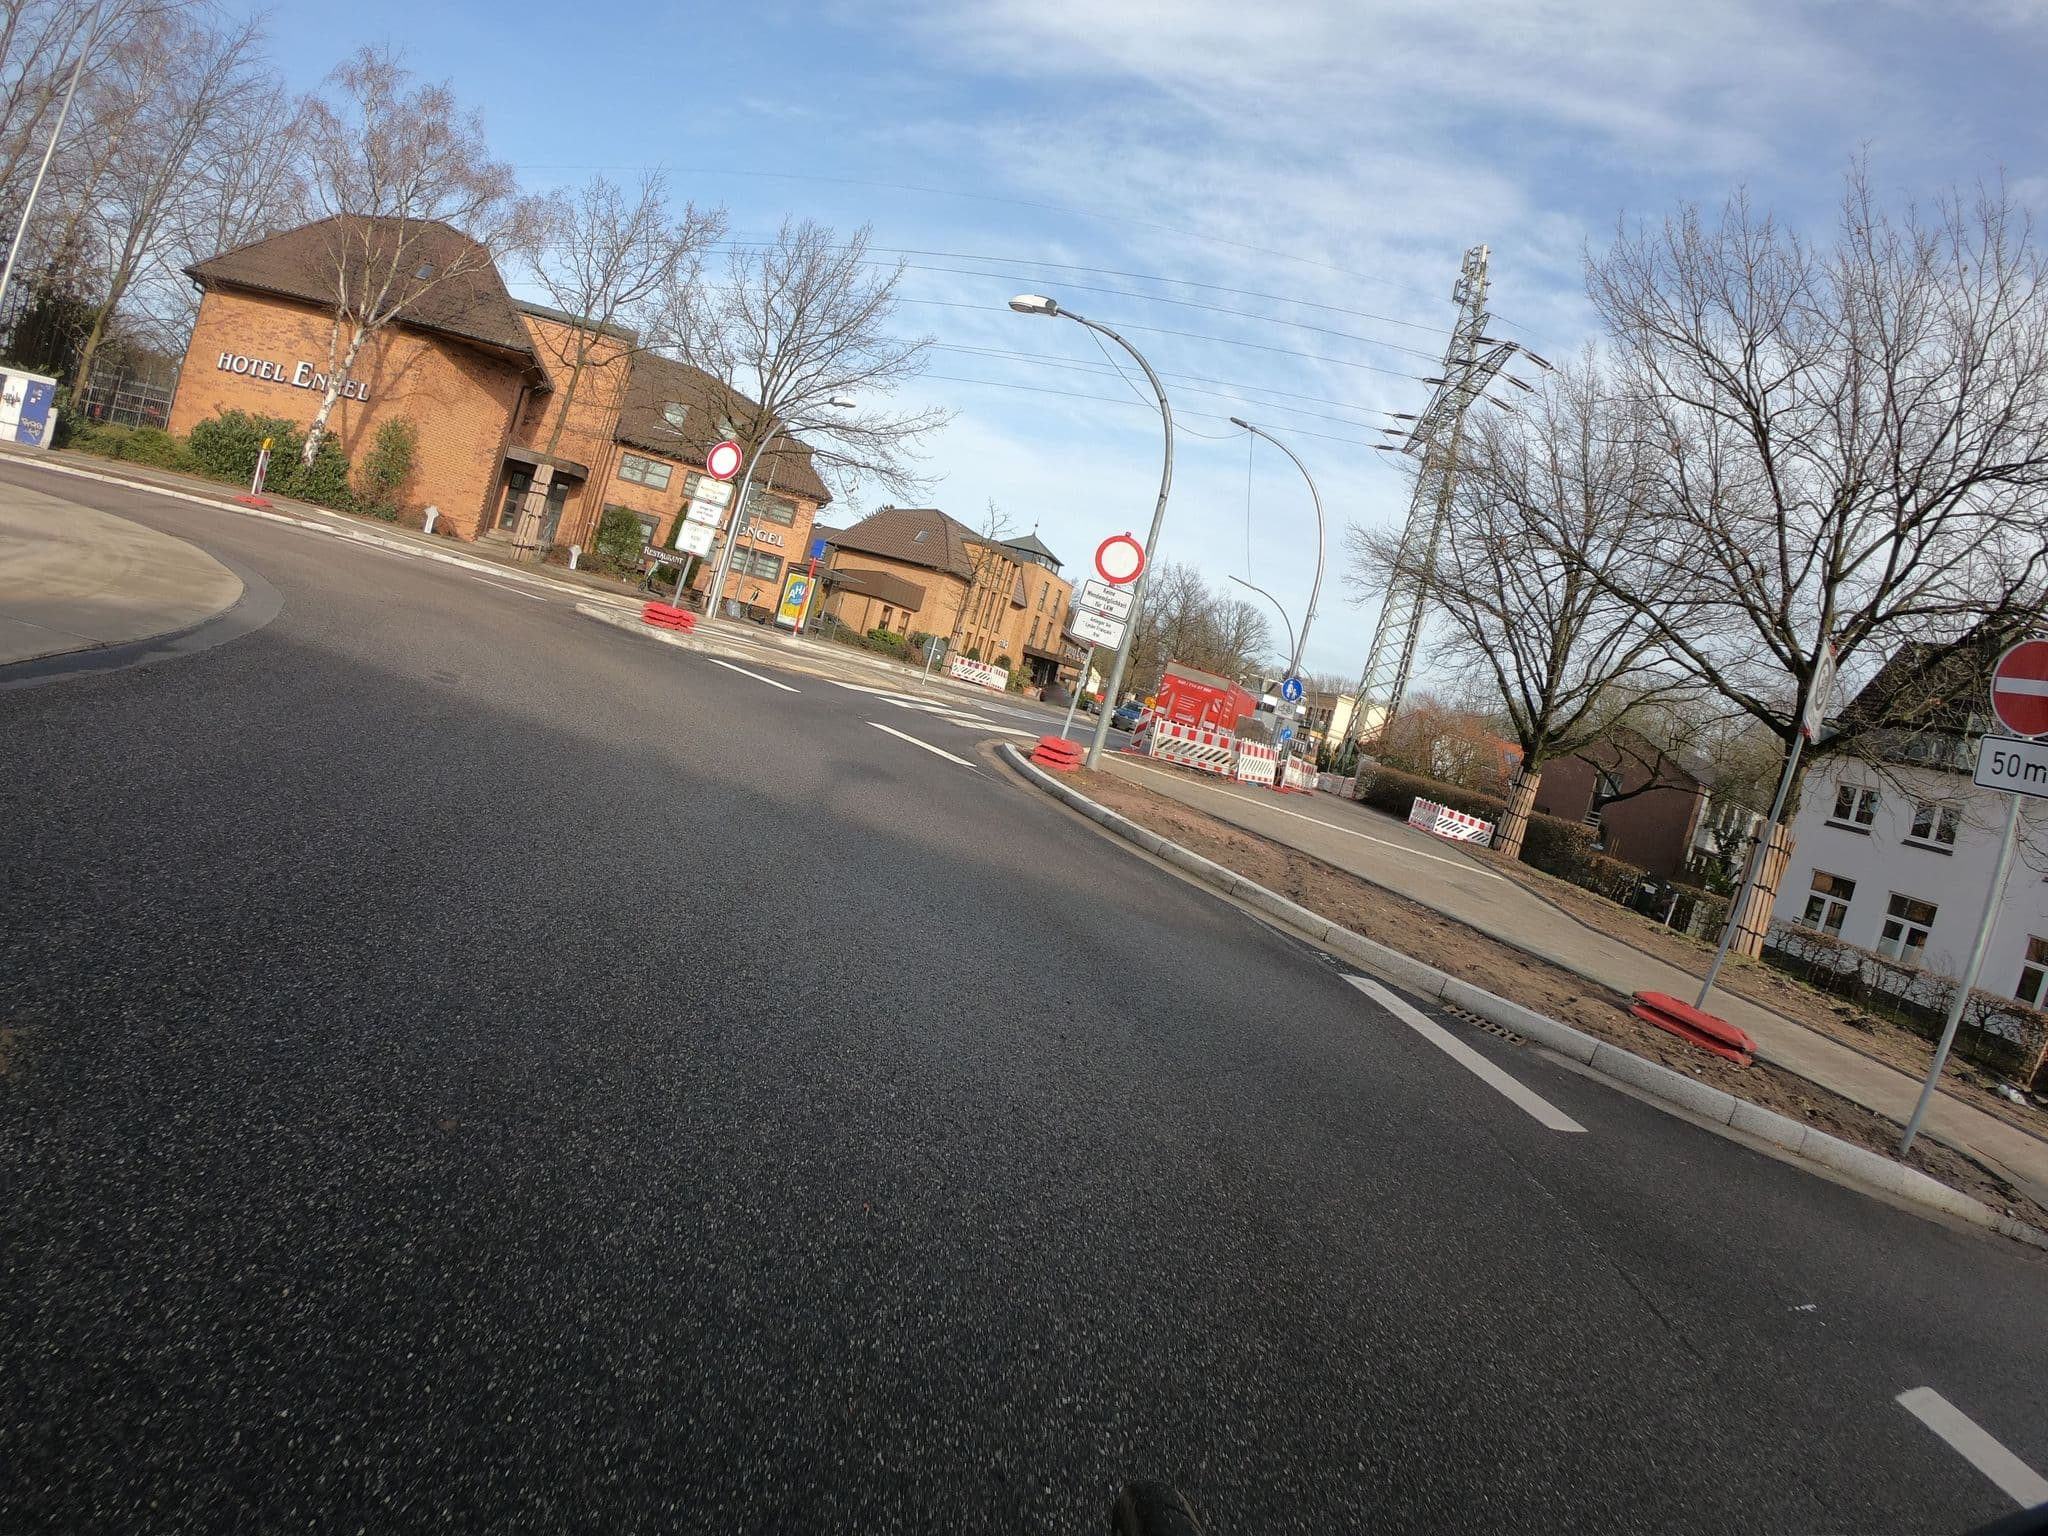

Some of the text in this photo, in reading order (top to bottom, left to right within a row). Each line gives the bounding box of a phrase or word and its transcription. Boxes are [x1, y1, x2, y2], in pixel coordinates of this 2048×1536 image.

[217, 352, 370, 401] HOTEL ENEL
[1992, 751, 2047, 783] 50m
